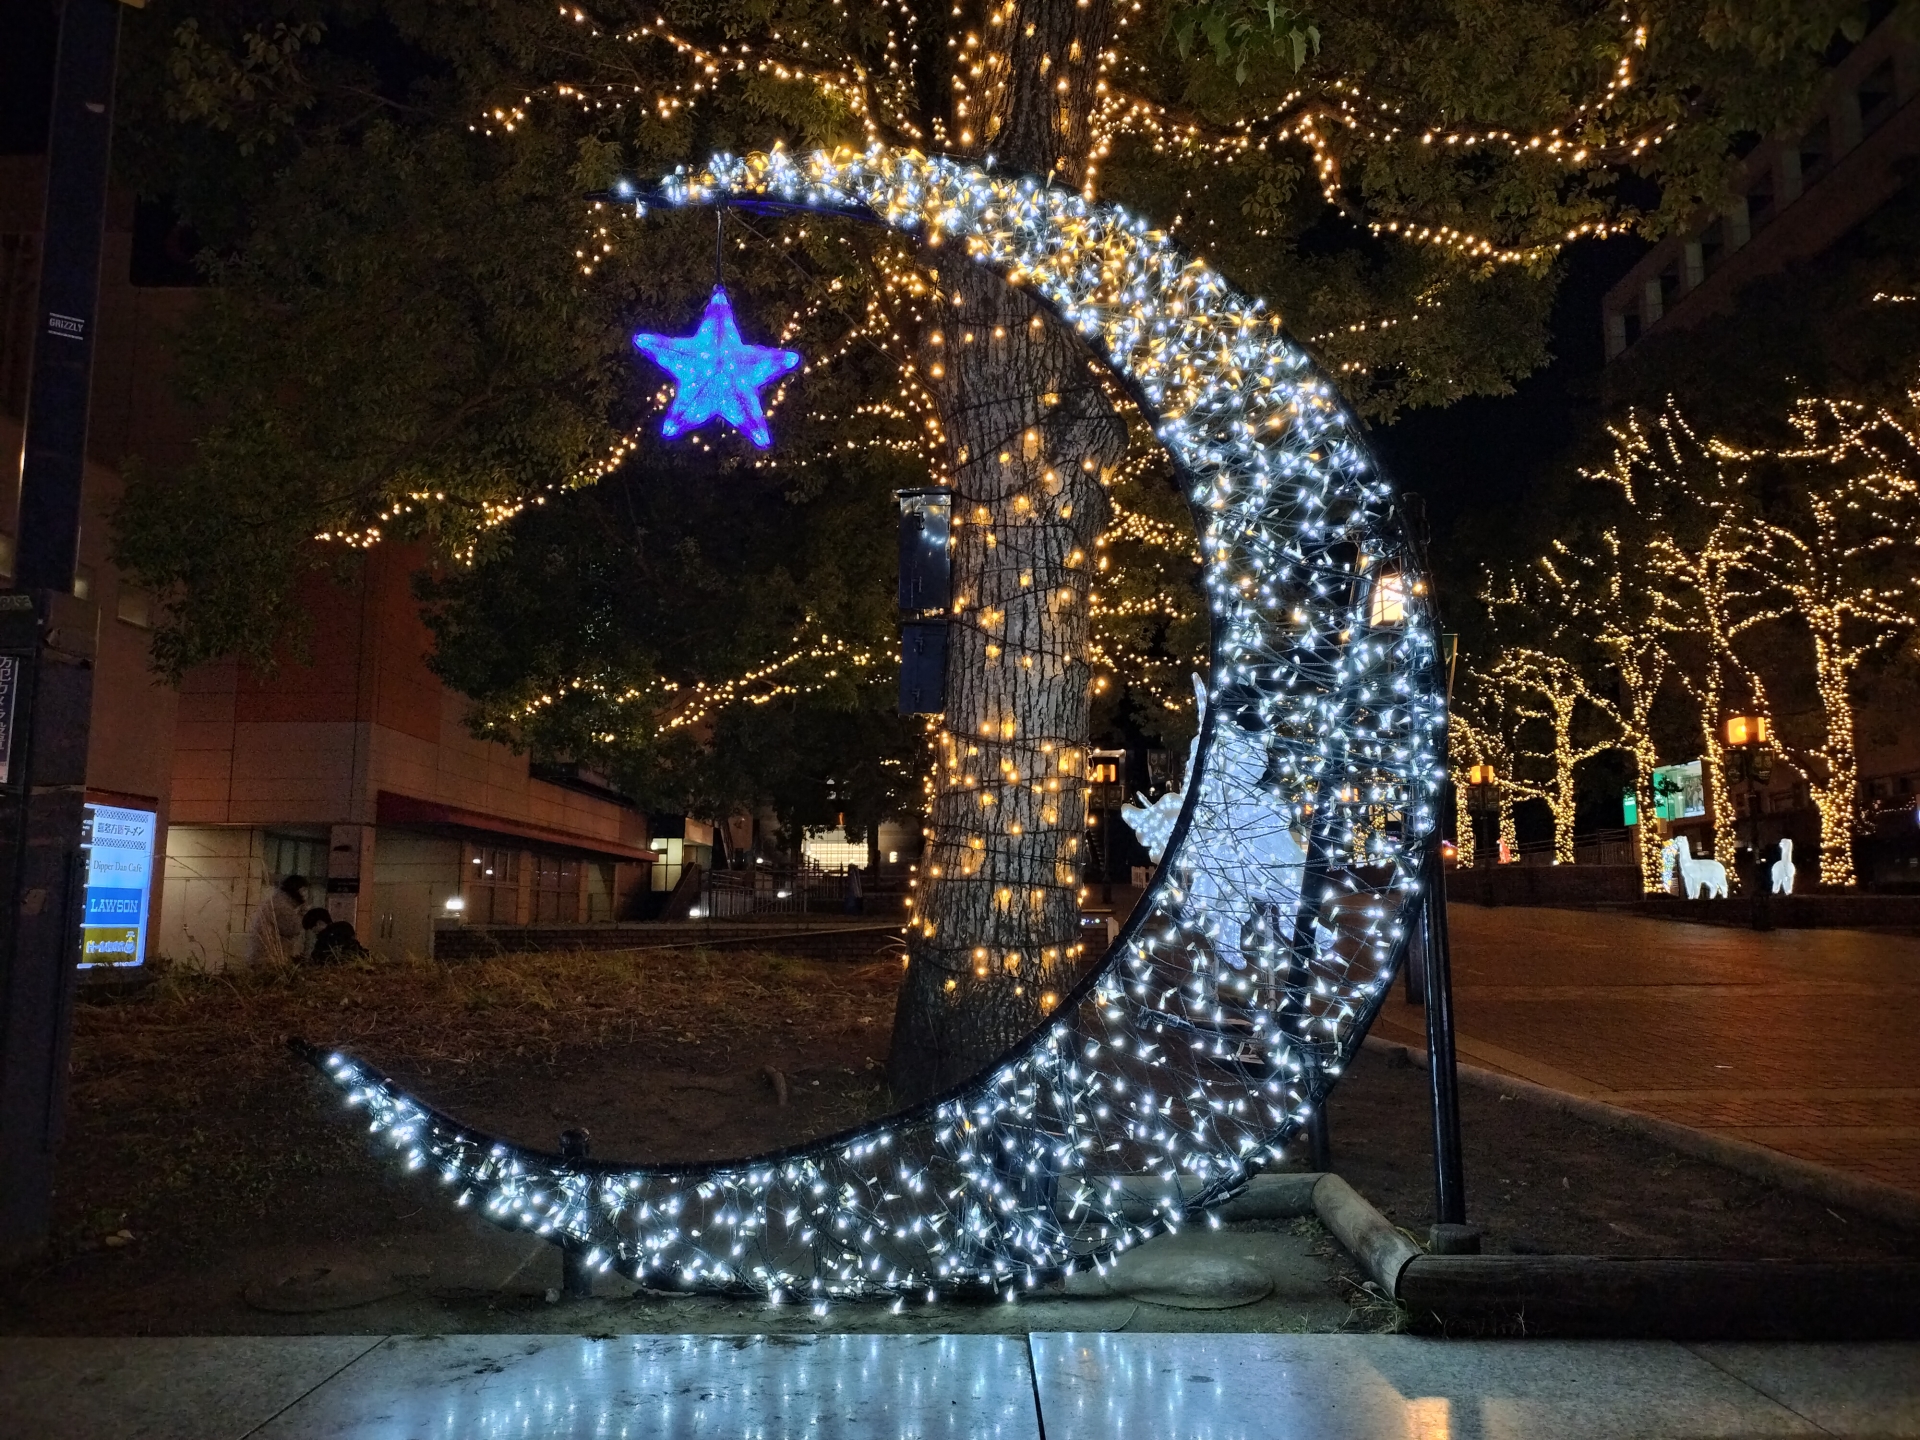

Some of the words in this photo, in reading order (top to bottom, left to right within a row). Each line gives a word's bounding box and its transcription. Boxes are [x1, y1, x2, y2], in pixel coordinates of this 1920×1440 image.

[49, 318, 83, 332] GRIZZLY
[93, 860, 114, 873] Dipper
[115, 861, 127, 872] Dan
[90, 898, 139, 913] LAWSON
